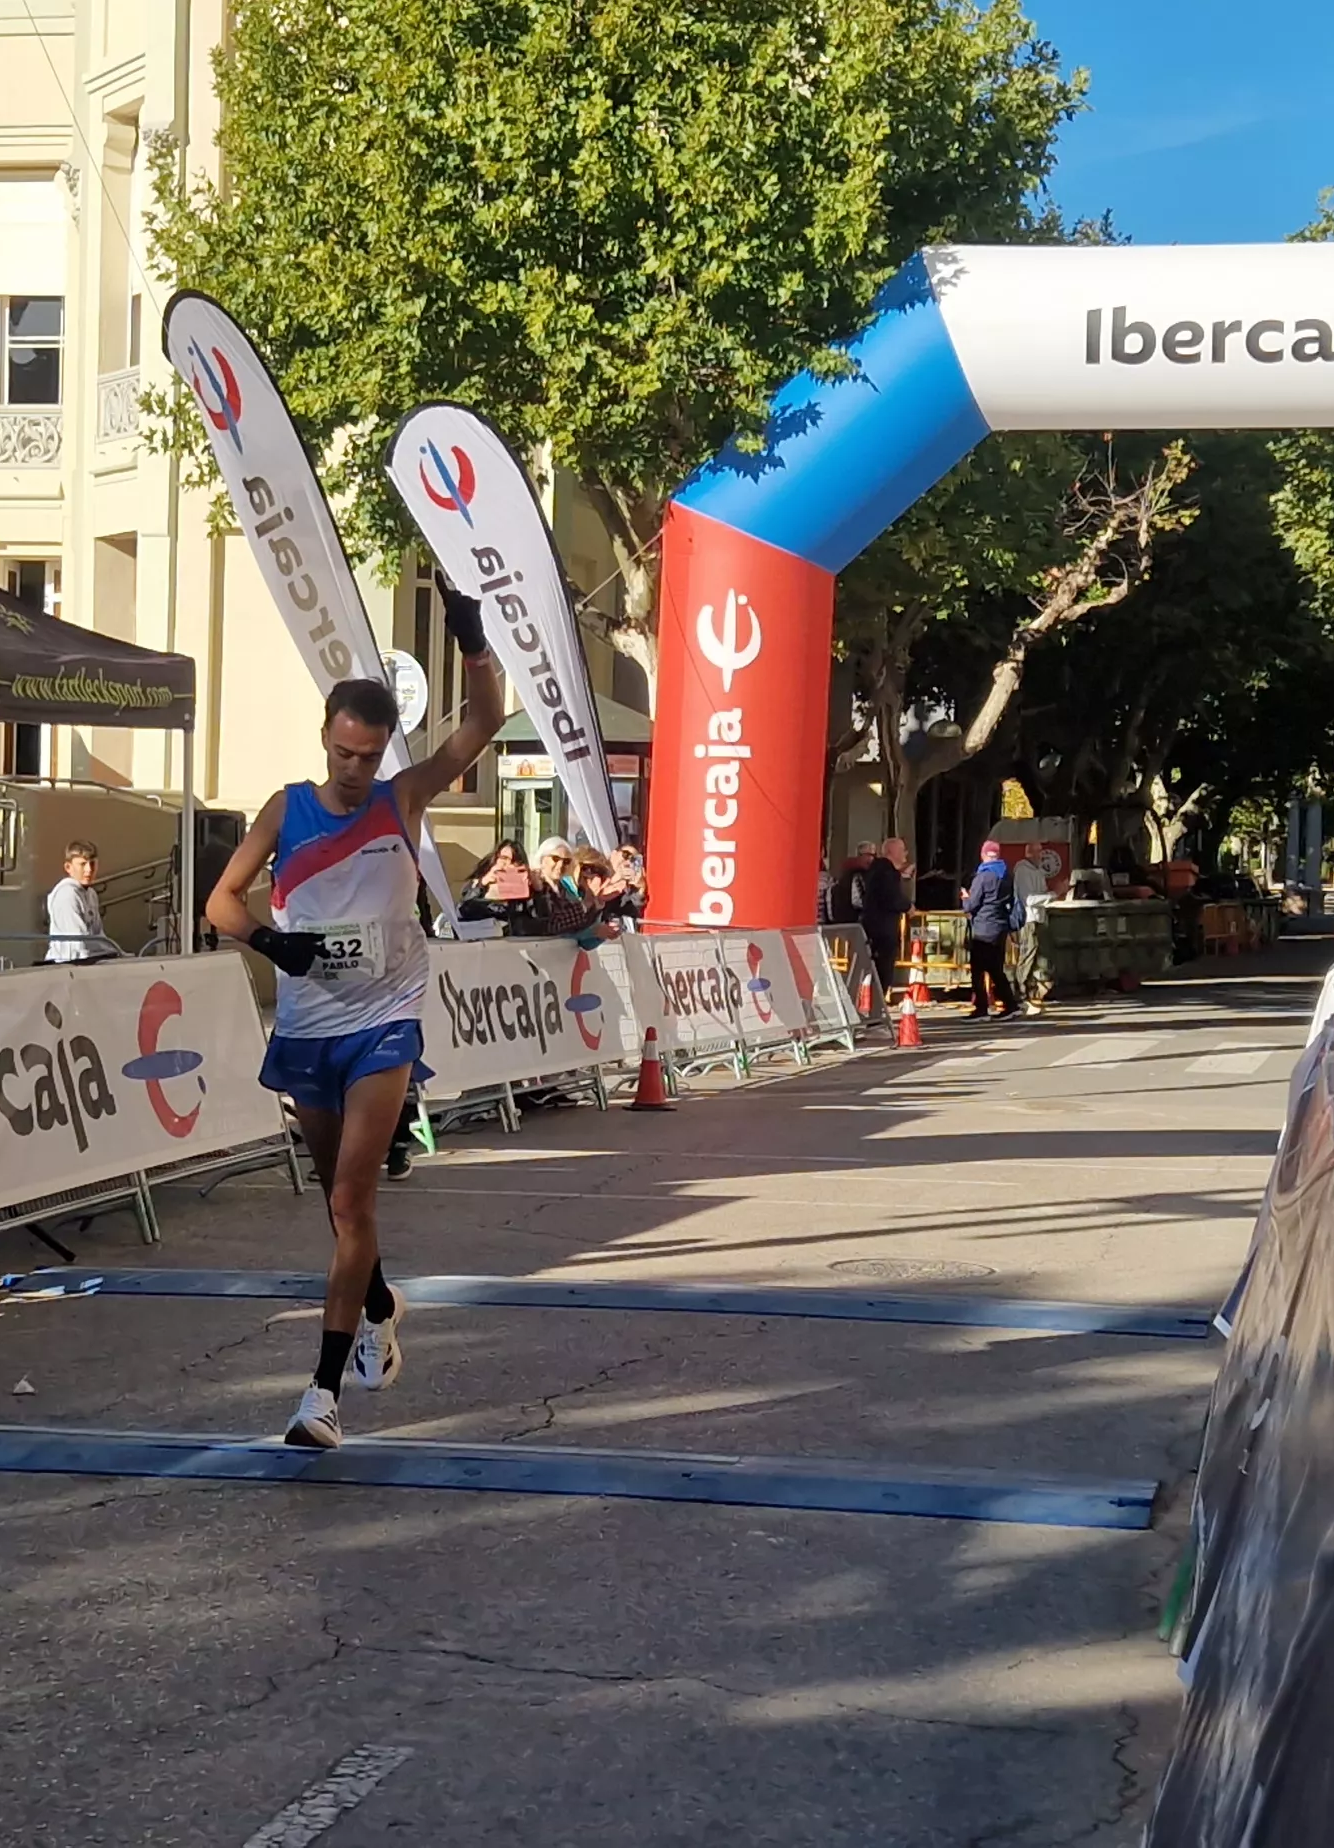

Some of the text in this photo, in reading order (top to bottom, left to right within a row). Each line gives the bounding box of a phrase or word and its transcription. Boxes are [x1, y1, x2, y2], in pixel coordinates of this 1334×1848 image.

[688, 708, 751, 926] bercaja
[323, 960, 359, 971] PABLO
[324, 939, 363, 959] 32
[438, 969, 563, 1055] Ibercaja
